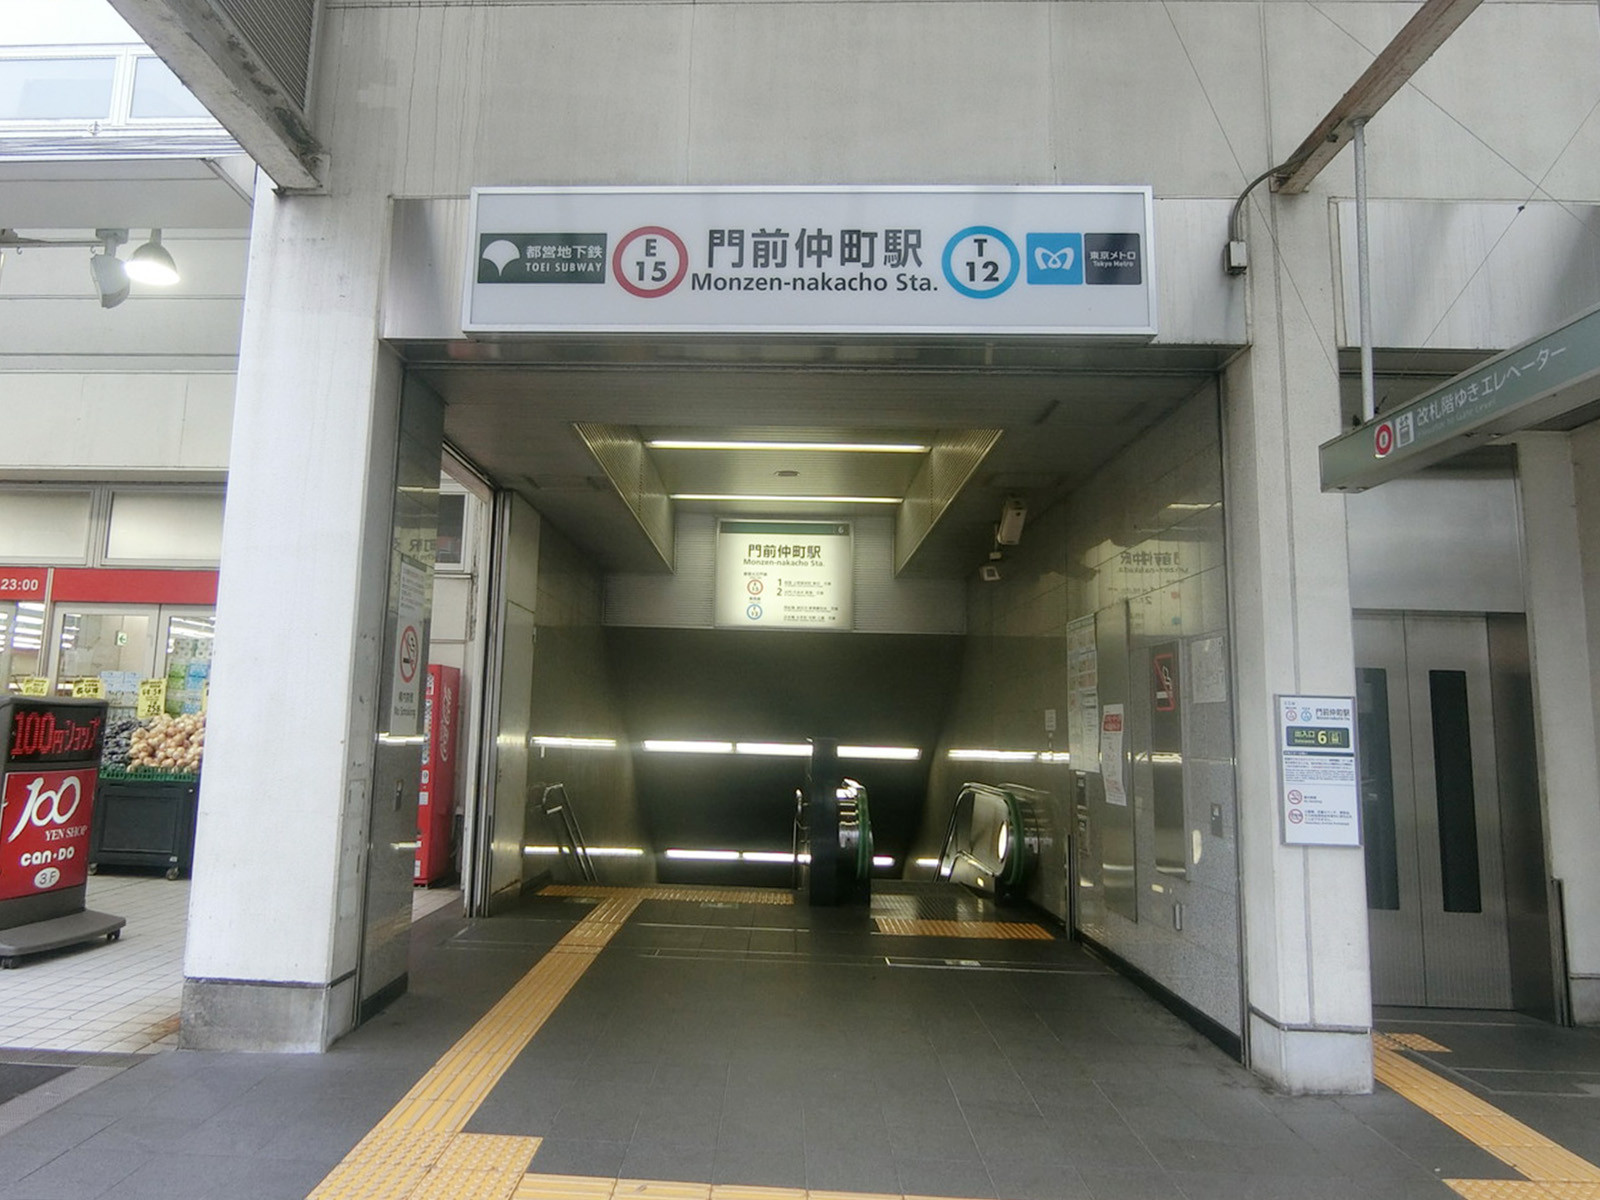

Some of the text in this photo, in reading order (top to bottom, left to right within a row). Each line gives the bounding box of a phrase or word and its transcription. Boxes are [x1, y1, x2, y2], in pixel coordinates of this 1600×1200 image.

[526, 245, 603, 260] 都営地下鉄
[645, 239, 657, 257] E
[708, 228, 923, 269] 門前仲町駅
[973, 238, 987, 257] T
[1089, 251, 1136, 260] 東京メトロ
[525, 262, 602, 273] TOEI SUBWAY
[1092, 260, 1134, 268] Tokyo Metro
[635, 261, 667, 282] 15
[965, 261, 999, 282] 12
[691, 272, 938, 291] Monzen-nakacho Sta.
[838, 526, 844, 534] 6
[748, 544, 821, 559] 門前仲町駅
[743, 558, 809, 566] Monzen-nakacho
[1, 578, 39, 591] 23:00
[777, 578, 782, 587] 1
[776, 588, 782, 596] 2
[1317, 730, 1327, 744] 6
[44, 825, 88, 842] YEN SHOP
